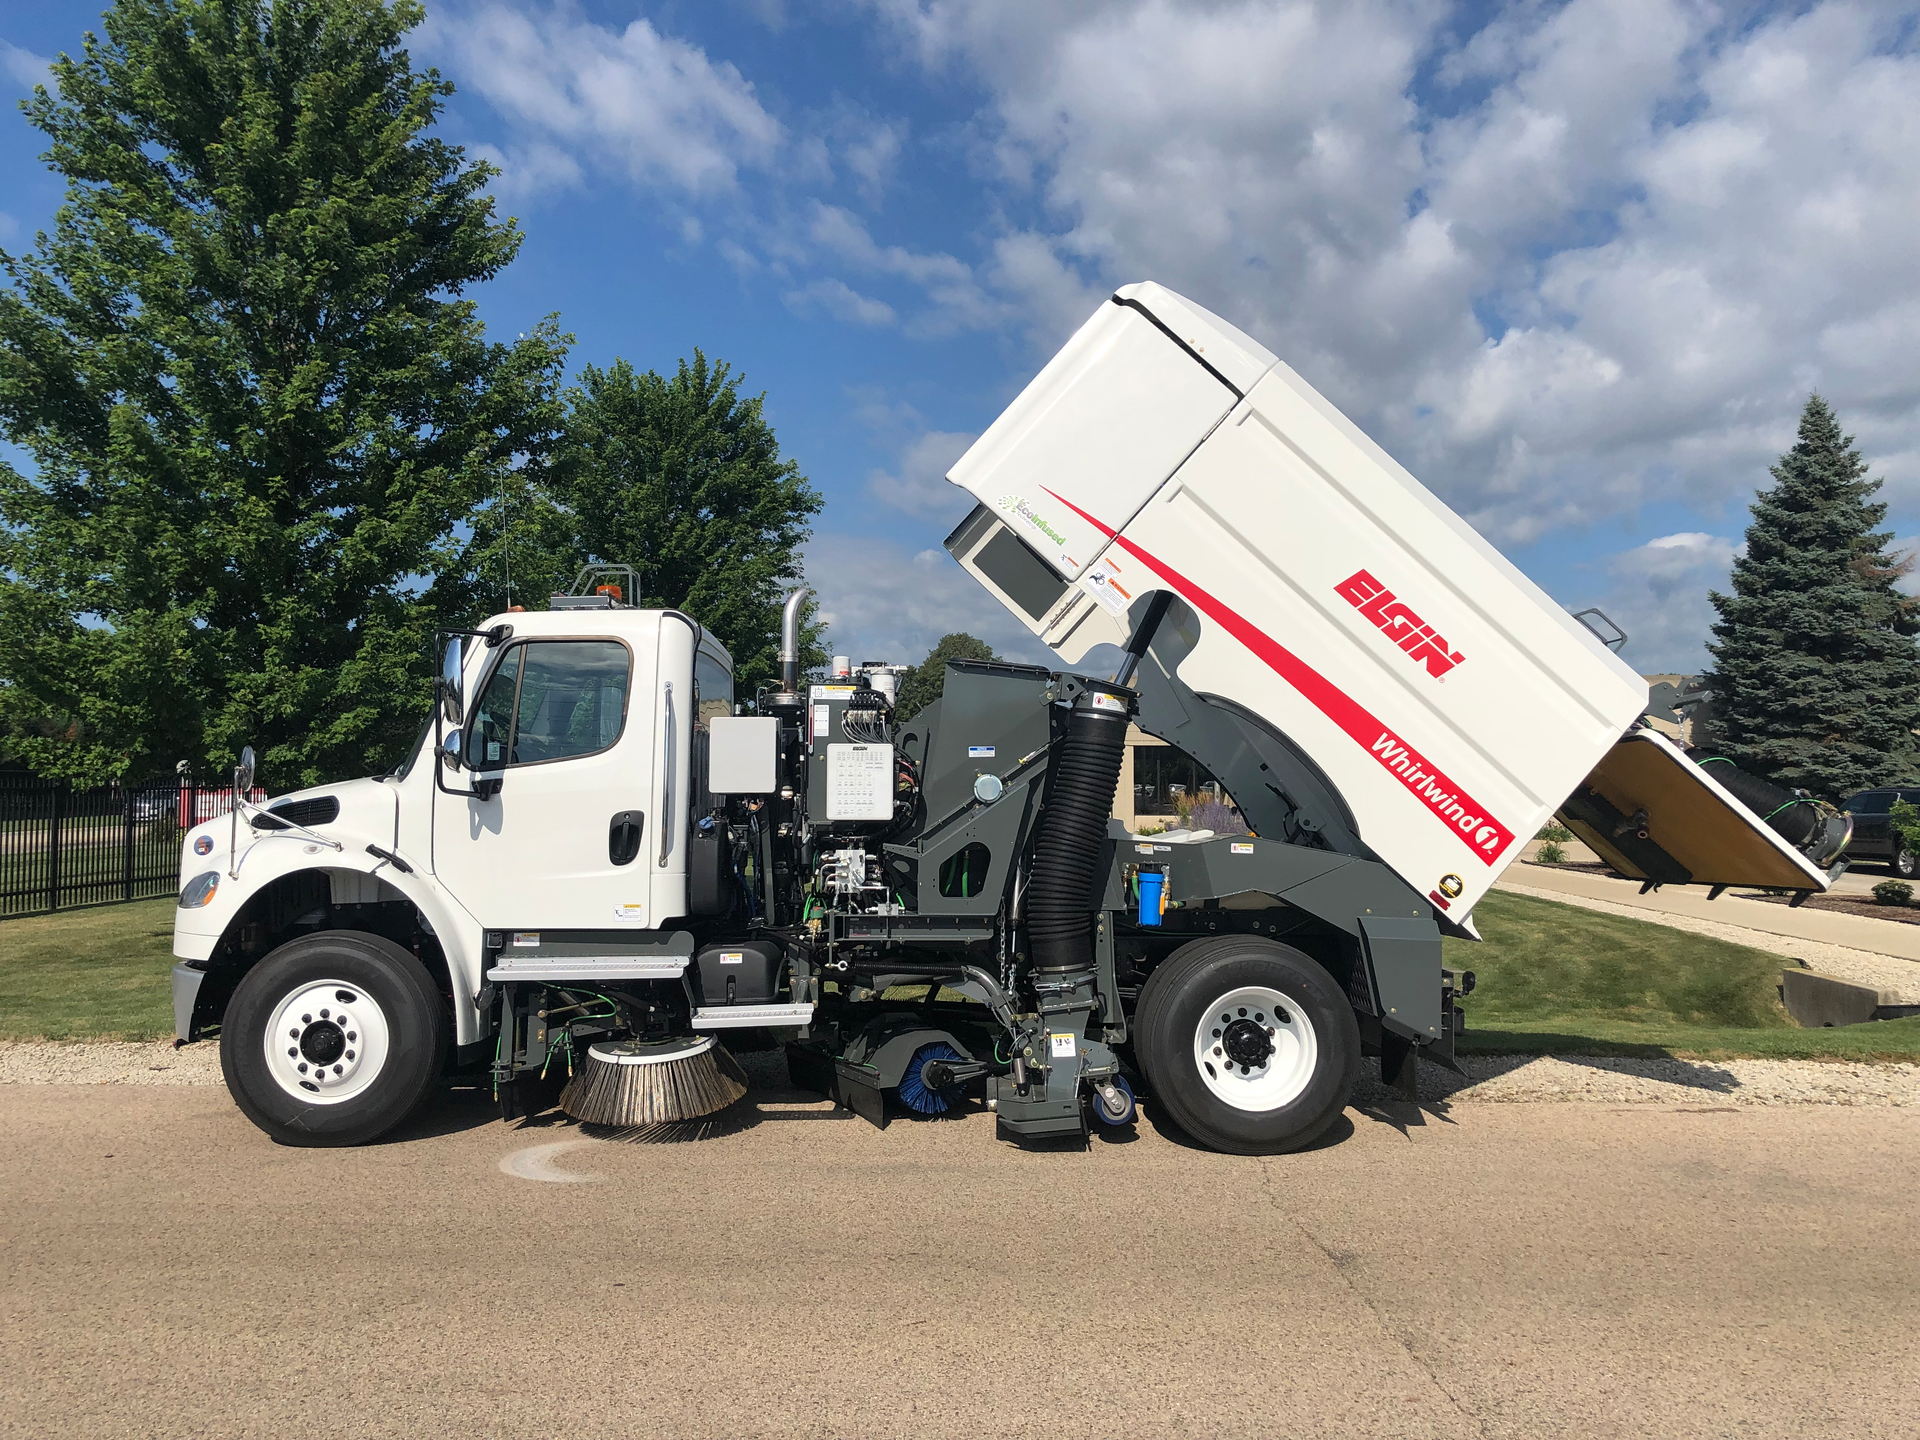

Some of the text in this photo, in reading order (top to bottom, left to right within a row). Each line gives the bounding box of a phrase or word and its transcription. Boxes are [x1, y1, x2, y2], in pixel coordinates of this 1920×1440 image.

[1016, 501, 1066, 546] EcoInfused
[1333, 568, 1466, 679] ELGIN
[1371, 732, 1483, 833] Whirlwind
